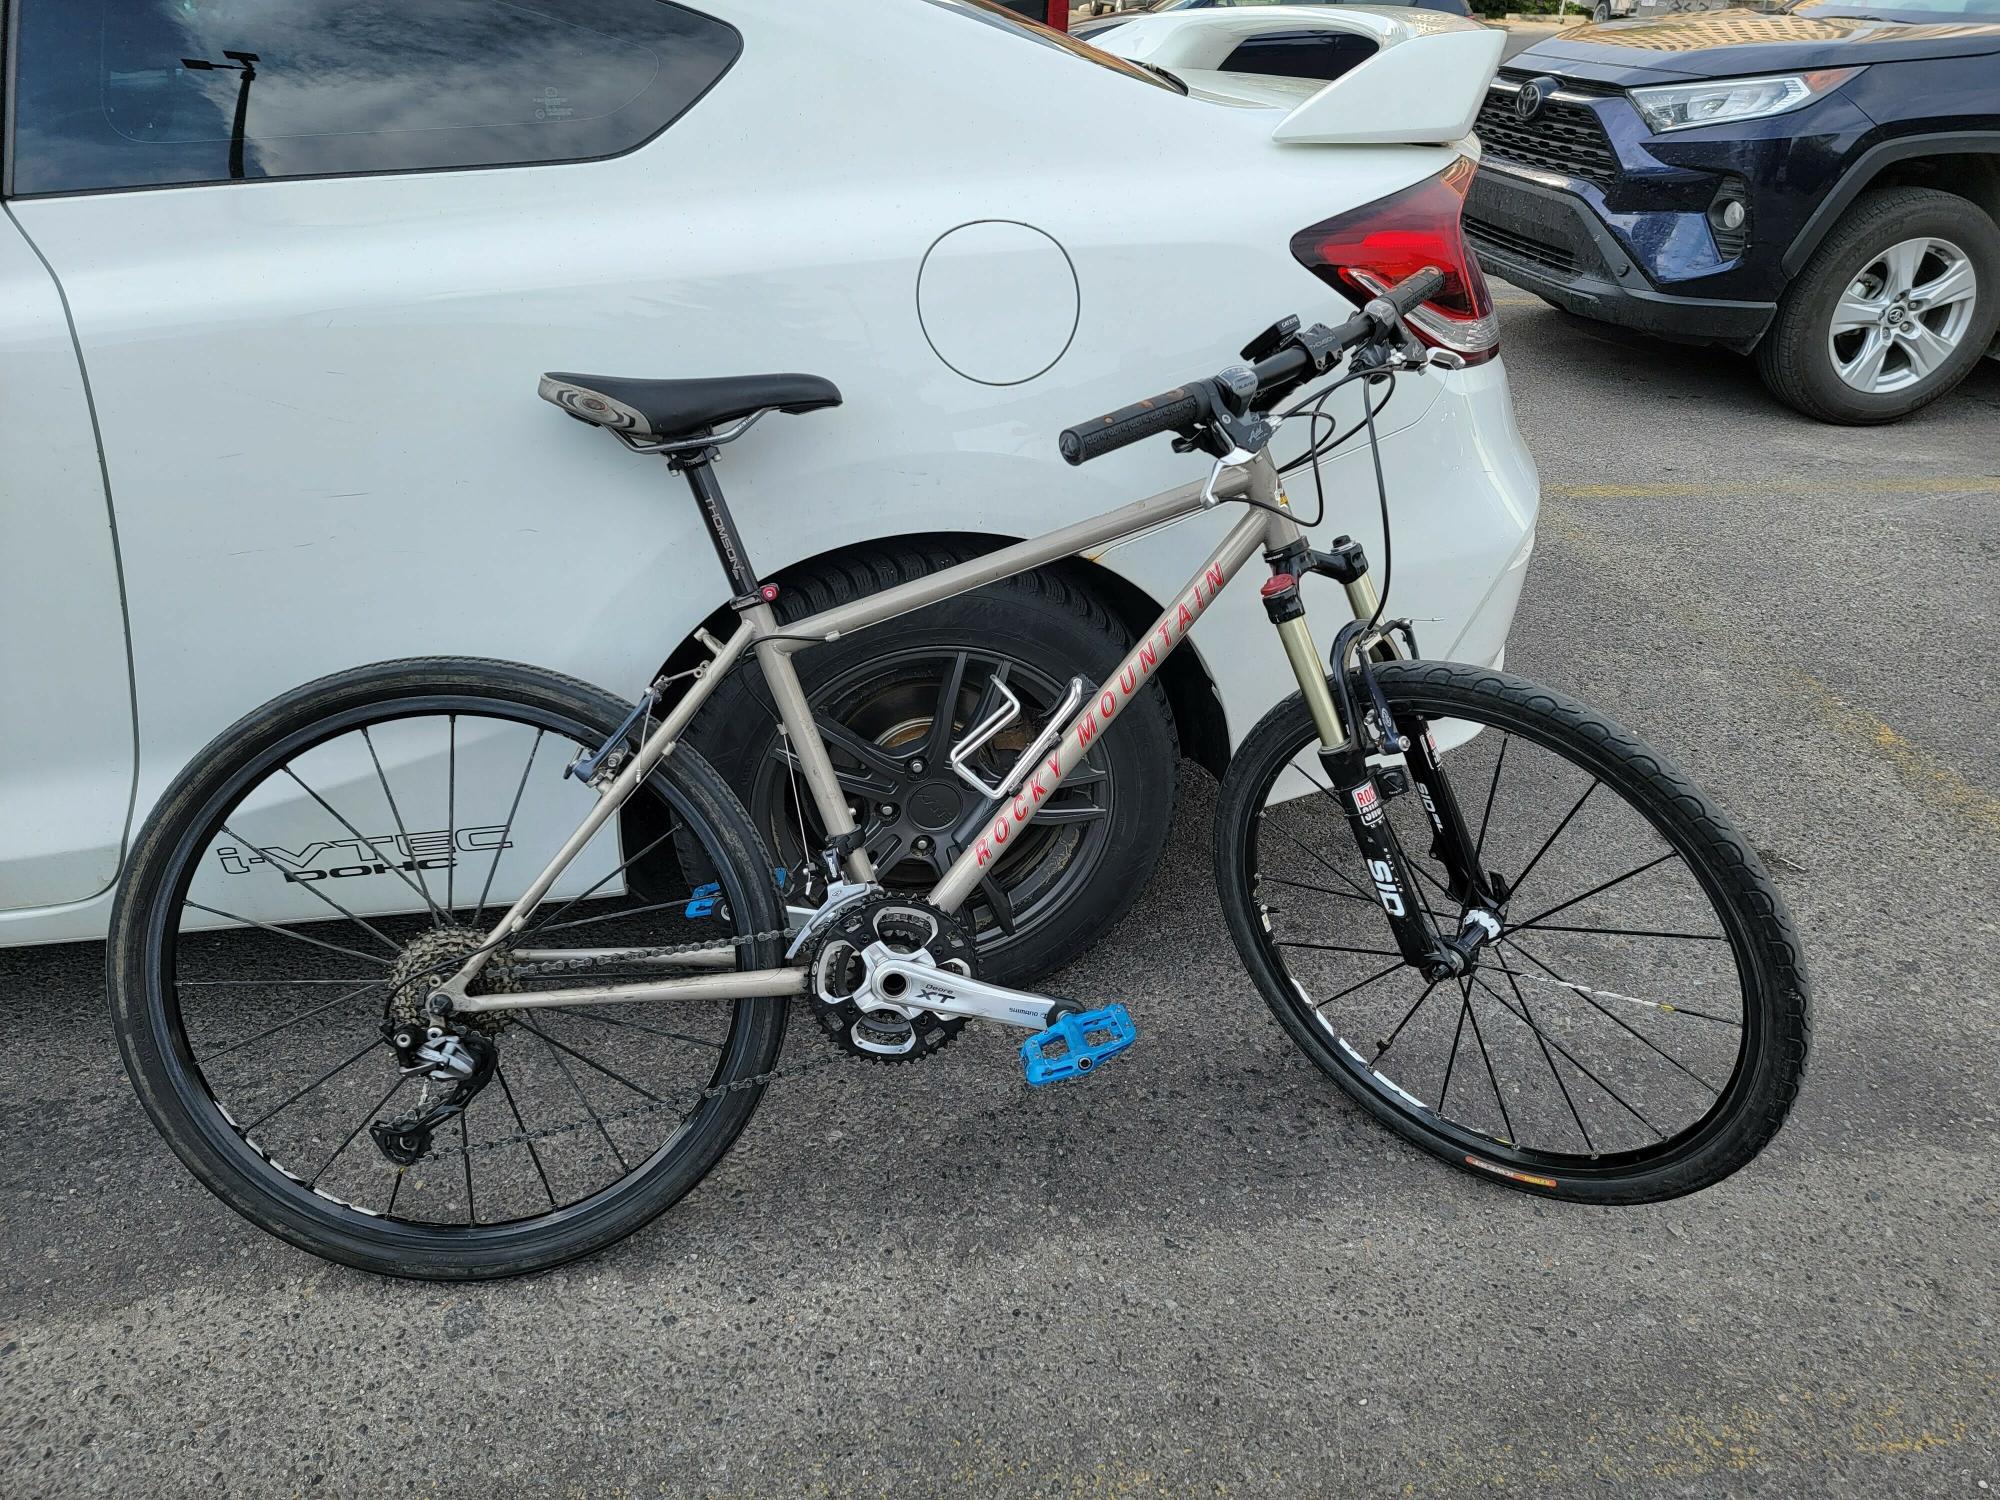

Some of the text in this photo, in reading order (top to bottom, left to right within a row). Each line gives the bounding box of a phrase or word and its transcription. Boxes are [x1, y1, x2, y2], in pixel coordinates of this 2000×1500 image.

[705, 494, 743, 571] THOMSON
[975, 750, 1062, 868] ROCKY
[1075, 560, 1226, 748] MOUNTAIN
[1416, 781, 1436, 813] SID
[284, 857, 458, 882] DOHC
[1367, 858, 1406, 917] SID
[915, 988, 956, 1004] XT
[925, 983, 954, 995] Deore
